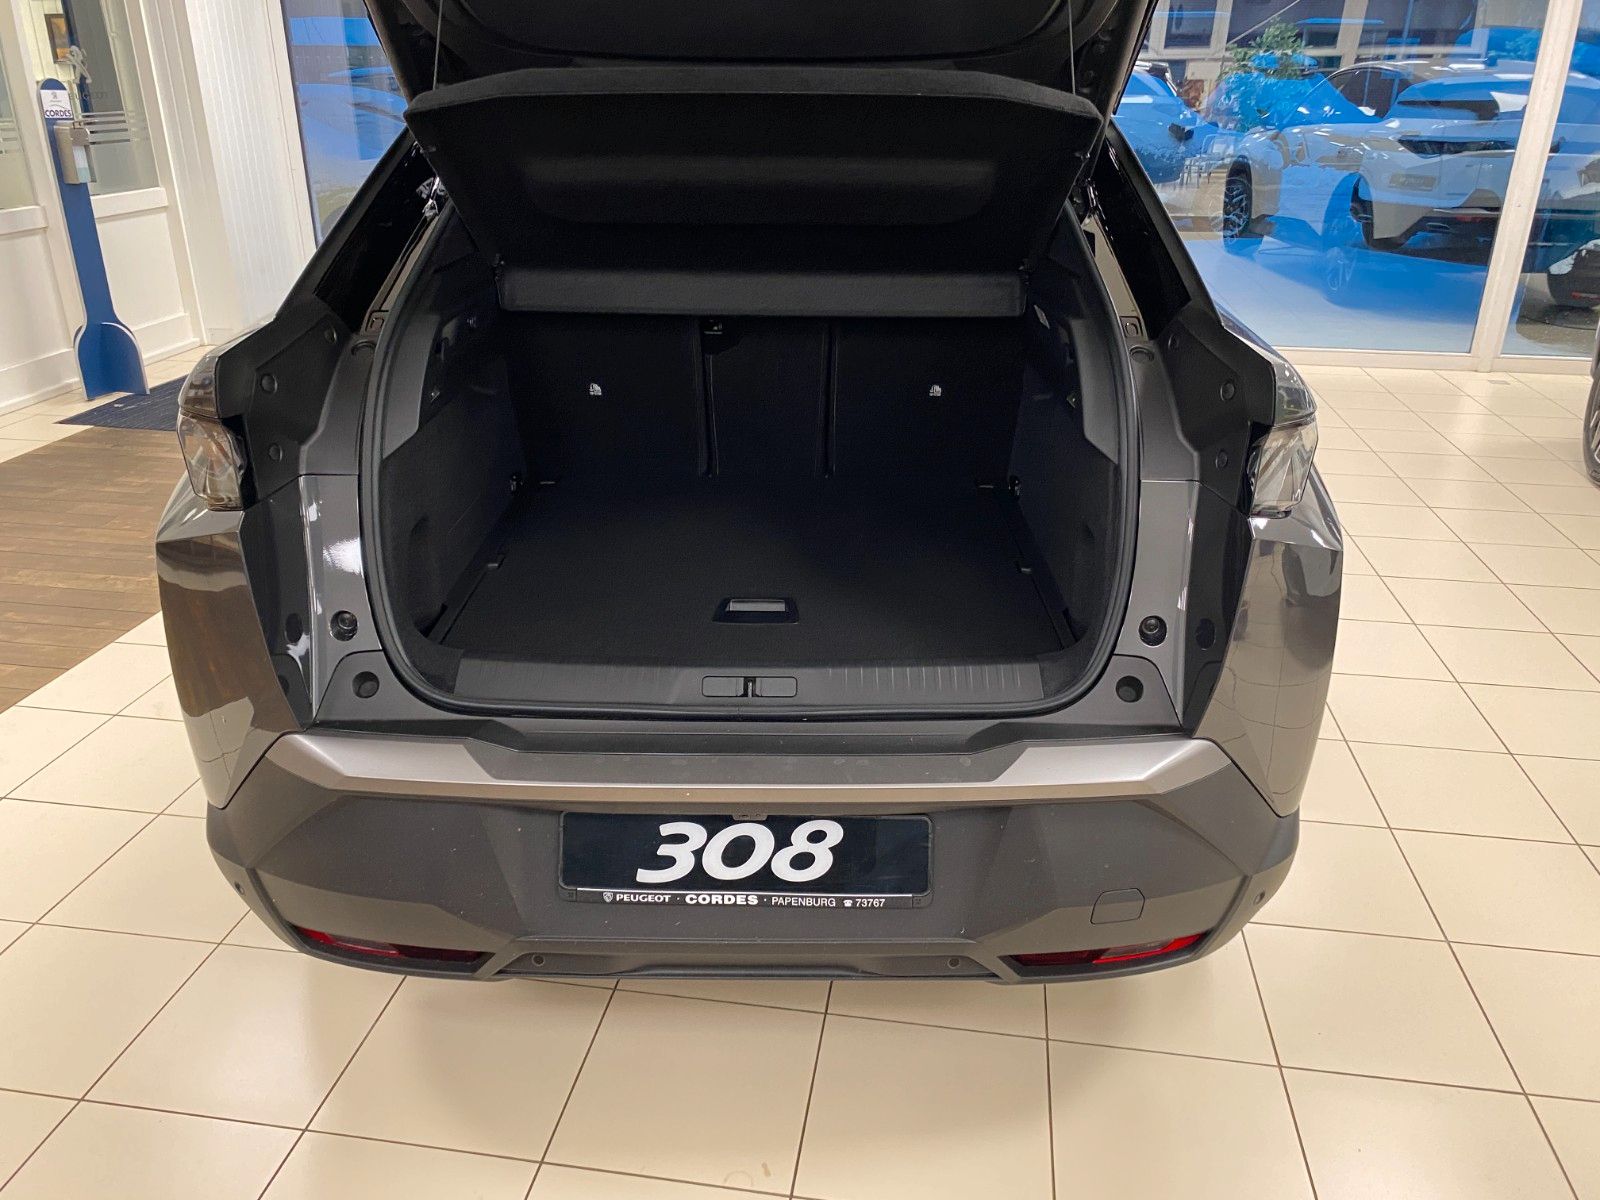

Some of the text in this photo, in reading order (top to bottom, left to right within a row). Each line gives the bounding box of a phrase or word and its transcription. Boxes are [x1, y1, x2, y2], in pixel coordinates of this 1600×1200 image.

[44, 109, 72, 118] CORDES
[636, 819, 844, 883] 308
[616, 893, 886, 907] PEUGEOT CORDES PAPENBURG 73767
